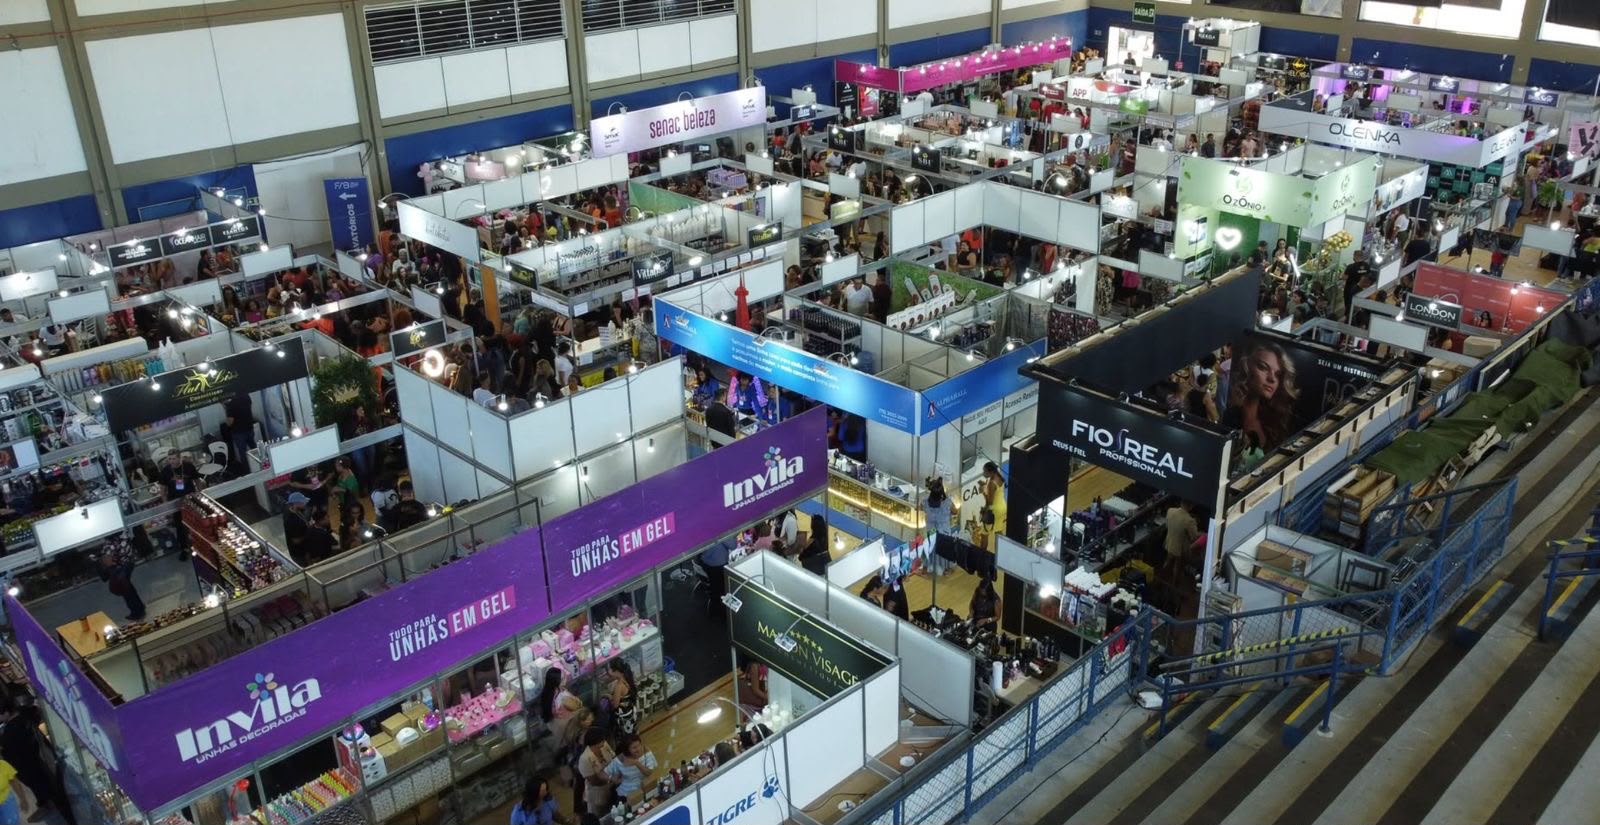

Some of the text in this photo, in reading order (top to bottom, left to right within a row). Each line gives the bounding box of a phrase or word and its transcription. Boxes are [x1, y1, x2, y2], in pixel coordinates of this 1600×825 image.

[649, 107, 716, 139] senac beleza
[1328, 122, 1401, 145] OLENKA
[1409, 302, 1457, 321] LONDON
[1333, 362, 1342, 370] UM
[1052, 439, 1069, 451] DEUS
[1073, 447, 1087, 458] FIEL
[1072, 418, 1194, 479] FIO REAL
[1099, 447, 1168, 479] PROFISSIONAL
[723, 452, 804, 508] Invila
[756, 478, 794, 500] DECORADAS
[571, 535, 610, 559] TUDO PARA
[571, 517, 671, 577] UNHAS EM GEL
[389, 591, 511, 662] UNHAS EM GEL
[389, 613, 437, 642] TUDO PARA
[757, 620, 808, 660] MAON
[175, 674, 322, 763] Invila
[195, 707, 307, 764] UNHAS DECORADAS
[705, 790, 757, 825] TIGRE
